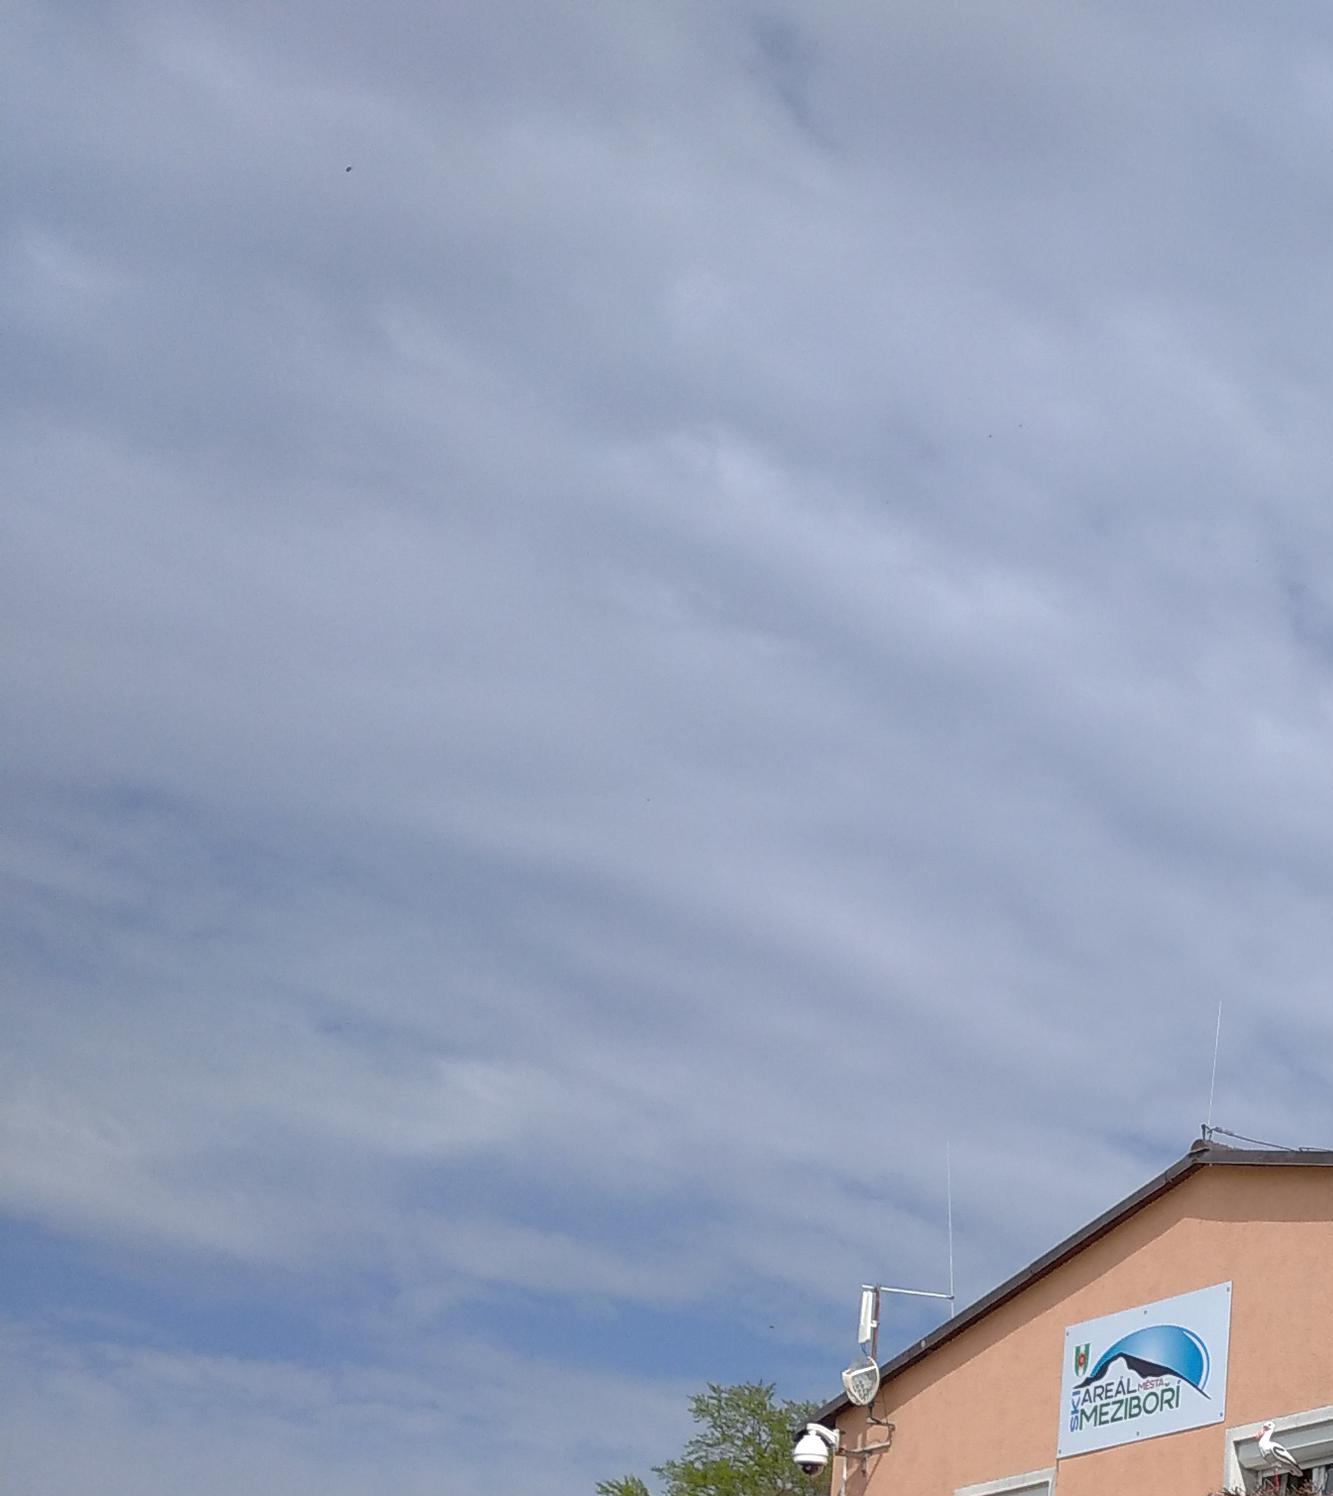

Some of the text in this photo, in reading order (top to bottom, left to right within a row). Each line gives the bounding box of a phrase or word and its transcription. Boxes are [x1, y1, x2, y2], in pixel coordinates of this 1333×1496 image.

[1070, 1390, 1081, 1432] SKI
[1079, 1379, 1181, 1431] MEZIBOŘÍ
[1081, 1376, 1137, 1406] AREÁL
